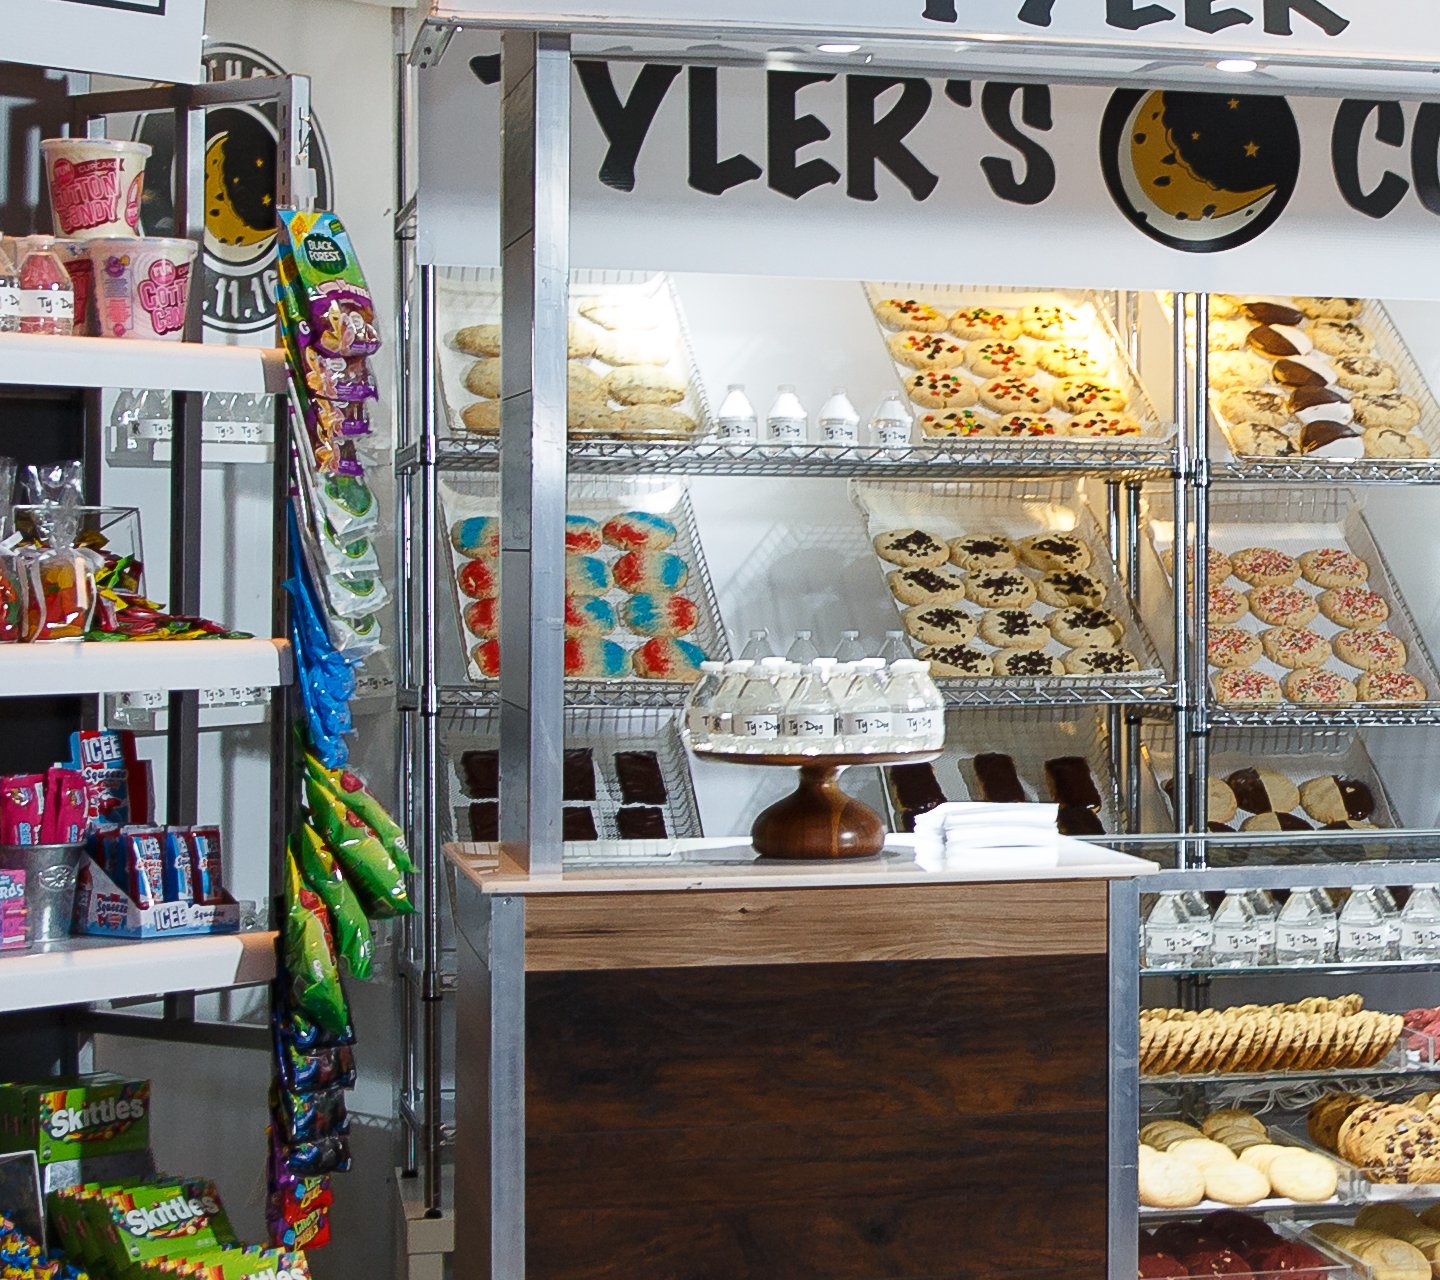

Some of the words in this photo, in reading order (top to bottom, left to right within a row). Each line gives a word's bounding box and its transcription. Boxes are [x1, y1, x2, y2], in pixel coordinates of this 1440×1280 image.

[469, 52, 1058, 206] YLER'S
[307, 239, 334, 252] BLACK
[308, 250, 343, 263] FOREST
[82, 735, 122, 763] ICEE
[84, 769, 127, 783] Squeeze
[95, 900, 128, 915] Squeeze
[153, 906, 188, 932] ICEE
[50, 1096, 145, 1139] Skittles
[125, 1193, 220, 1237] Skittles
